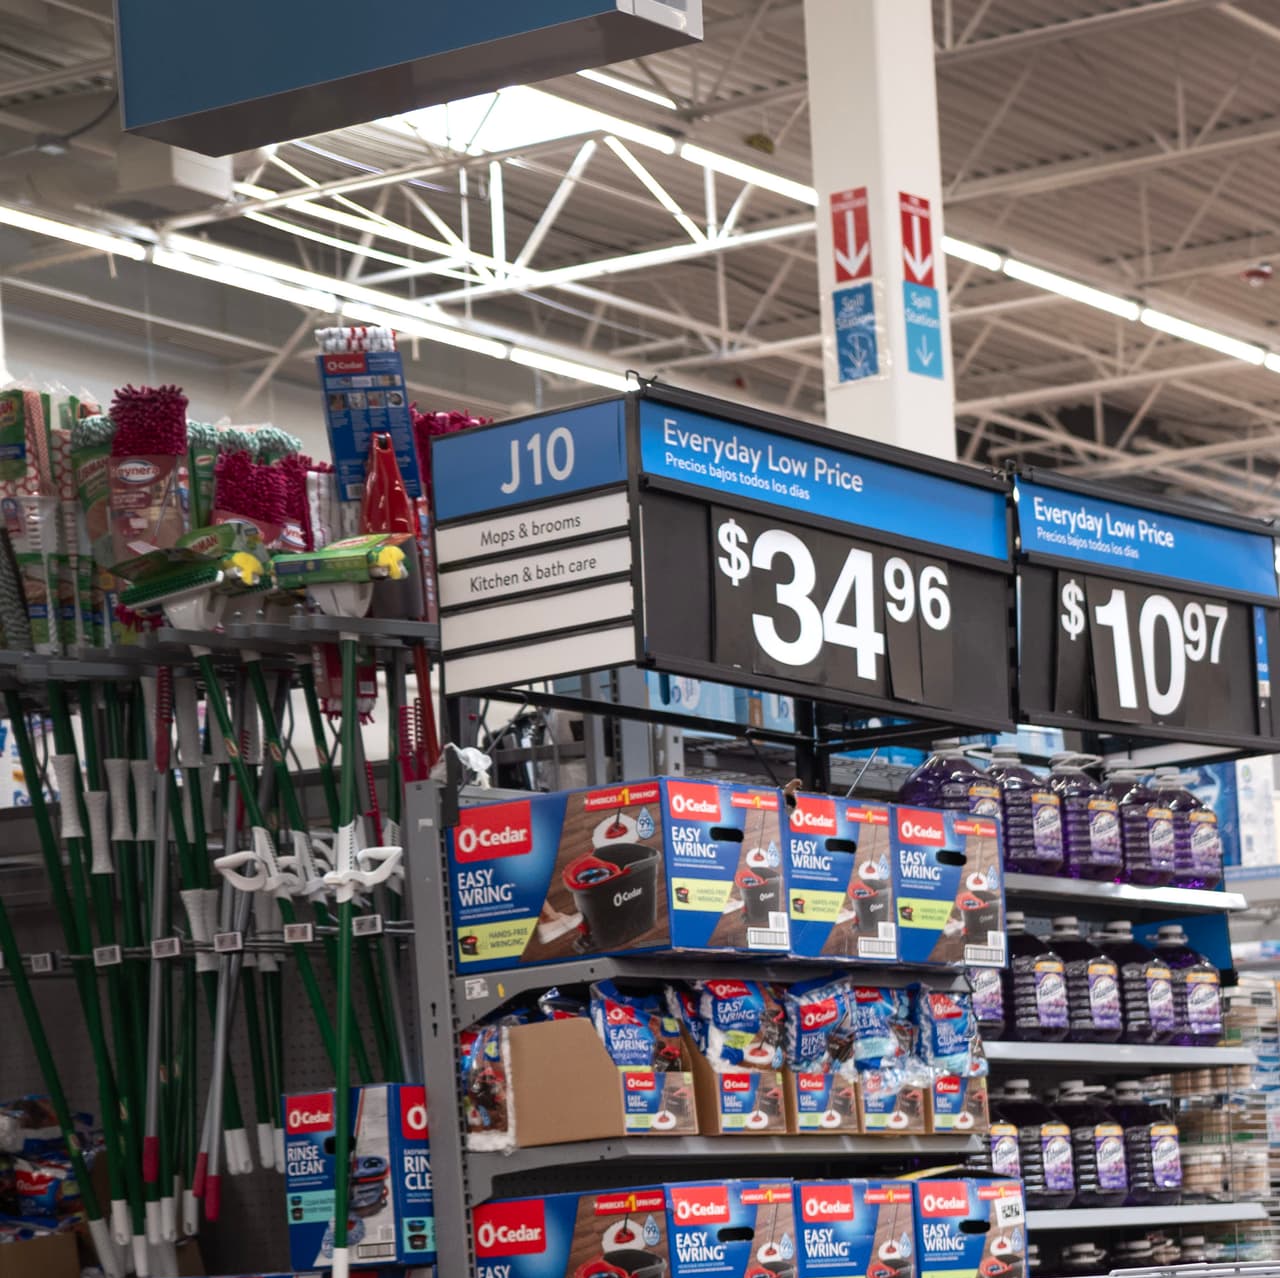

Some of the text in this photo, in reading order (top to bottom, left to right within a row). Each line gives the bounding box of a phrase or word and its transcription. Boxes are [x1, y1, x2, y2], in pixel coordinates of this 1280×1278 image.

[663, 418, 864, 493] Everyday Low Price
[665, 452, 707, 475] Precios
[709, 462, 738, 484] bajos
[740, 472, 770, 492] todos
[772, 478, 788, 495] los
[1034, 496, 1175, 548] Everyday Low Price
[480, 515, 581, 547] Mops & brooms
[1037, 527, 1067, 545] Precios
[470, 557, 597, 593] Kitchen & bath care
[672, 795, 718, 814] O-Cedar
[792, 808, 834, 828] O-Cedar
[671, 826, 701, 841] EASY
[901, 820, 943, 840] O-Cedar
[458, 826, 527, 853] O-Cedar
[791, 839, 818, 855] EASY
[672, 841, 717, 858] WRING
[900, 850, 926, 865] EASY
[791, 855, 832, 871] WRING
[458, 869, 494, 890] EASY
[901, 864, 941, 881] WRING
[458, 884, 513, 907] WRING
[613, 887, 642, 907] O-Cedar
[717, 999, 743, 1013] EASY
[610, 1030, 639, 1040] EASY
[612, 1040, 649, 1051] WRING
[289, 1109, 330, 1128] O-Cedar
[287, 1146, 318, 1162] RINSE
[287, 1160, 324, 1176] CLEAN
[677, 1199, 726, 1219] O-Cedar
[805, 1198, 850, 1216] O-Cedar
[923, 1196, 965, 1212] O-Cedar
[478, 1221, 541, 1248] O-Cedar
[804, 1229, 832, 1244] EASY
[923, 1224, 950, 1238] EASY
[676, 1232, 707, 1248] EASY
[923, 1237, 964, 1252] WRING
[677, 1246, 724, 1262] WRING
[805, 1242, 849, 1258] WRING
